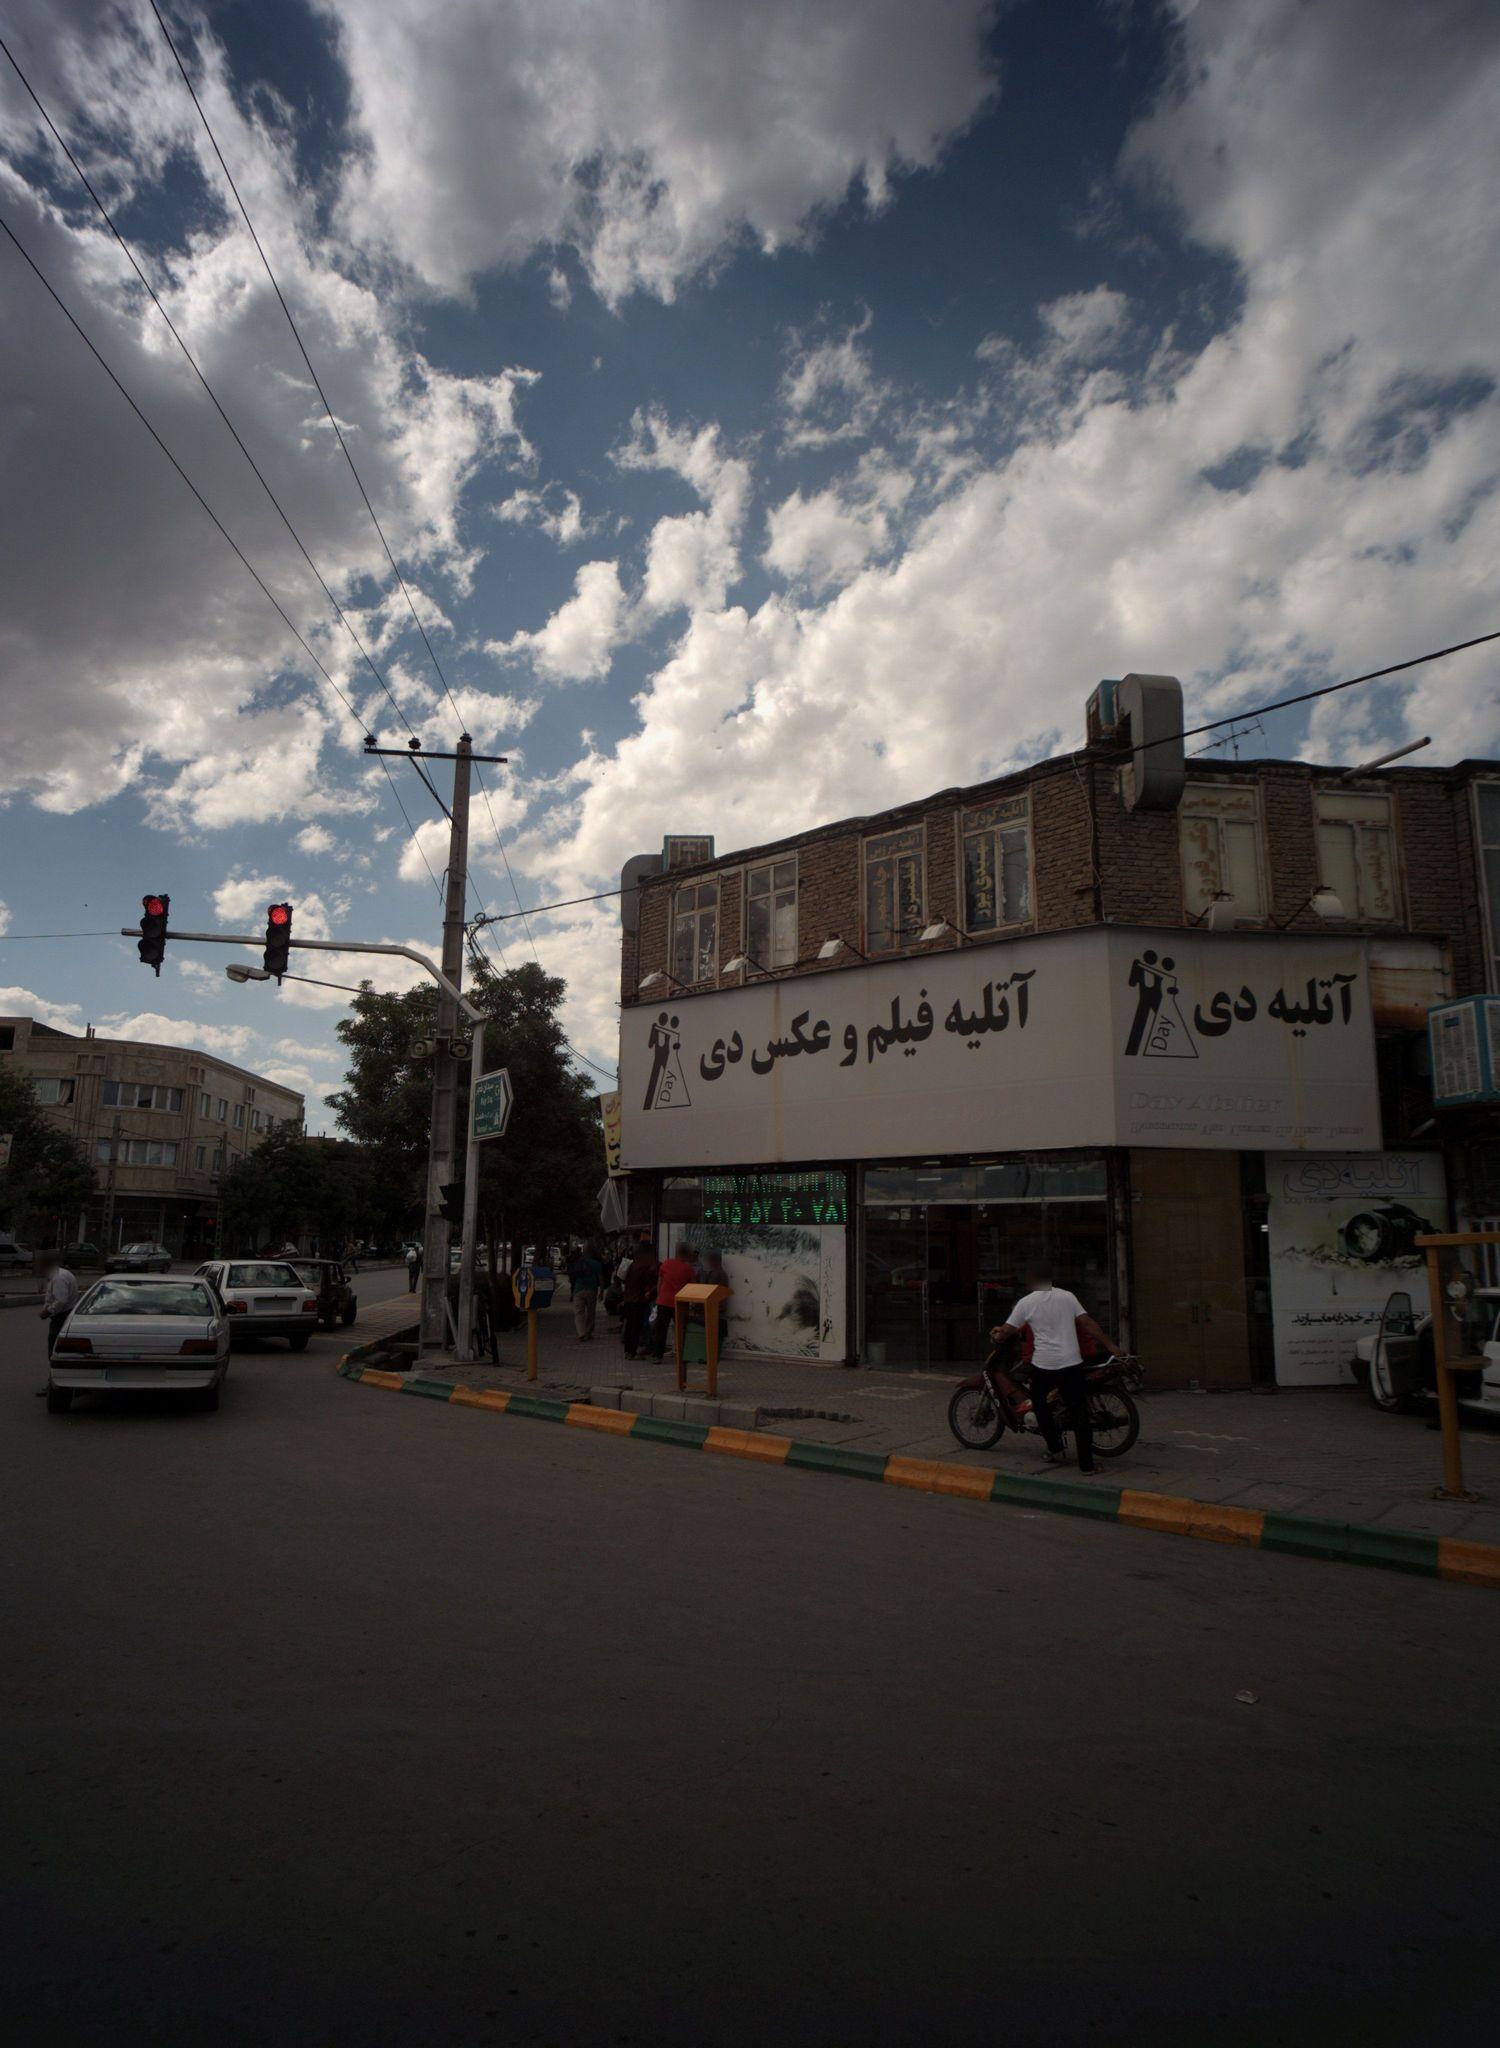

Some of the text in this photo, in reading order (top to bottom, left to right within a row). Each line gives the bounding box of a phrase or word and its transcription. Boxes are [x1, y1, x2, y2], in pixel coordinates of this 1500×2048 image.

[700, 969, 1036, 1081] آتلیه فیلم و عکس دی
[1194, 972, 1358, 1038] آتلیه دی
[1151, 1015, 1176, 1051] Day
[659, 1069, 675, 1104] Day
